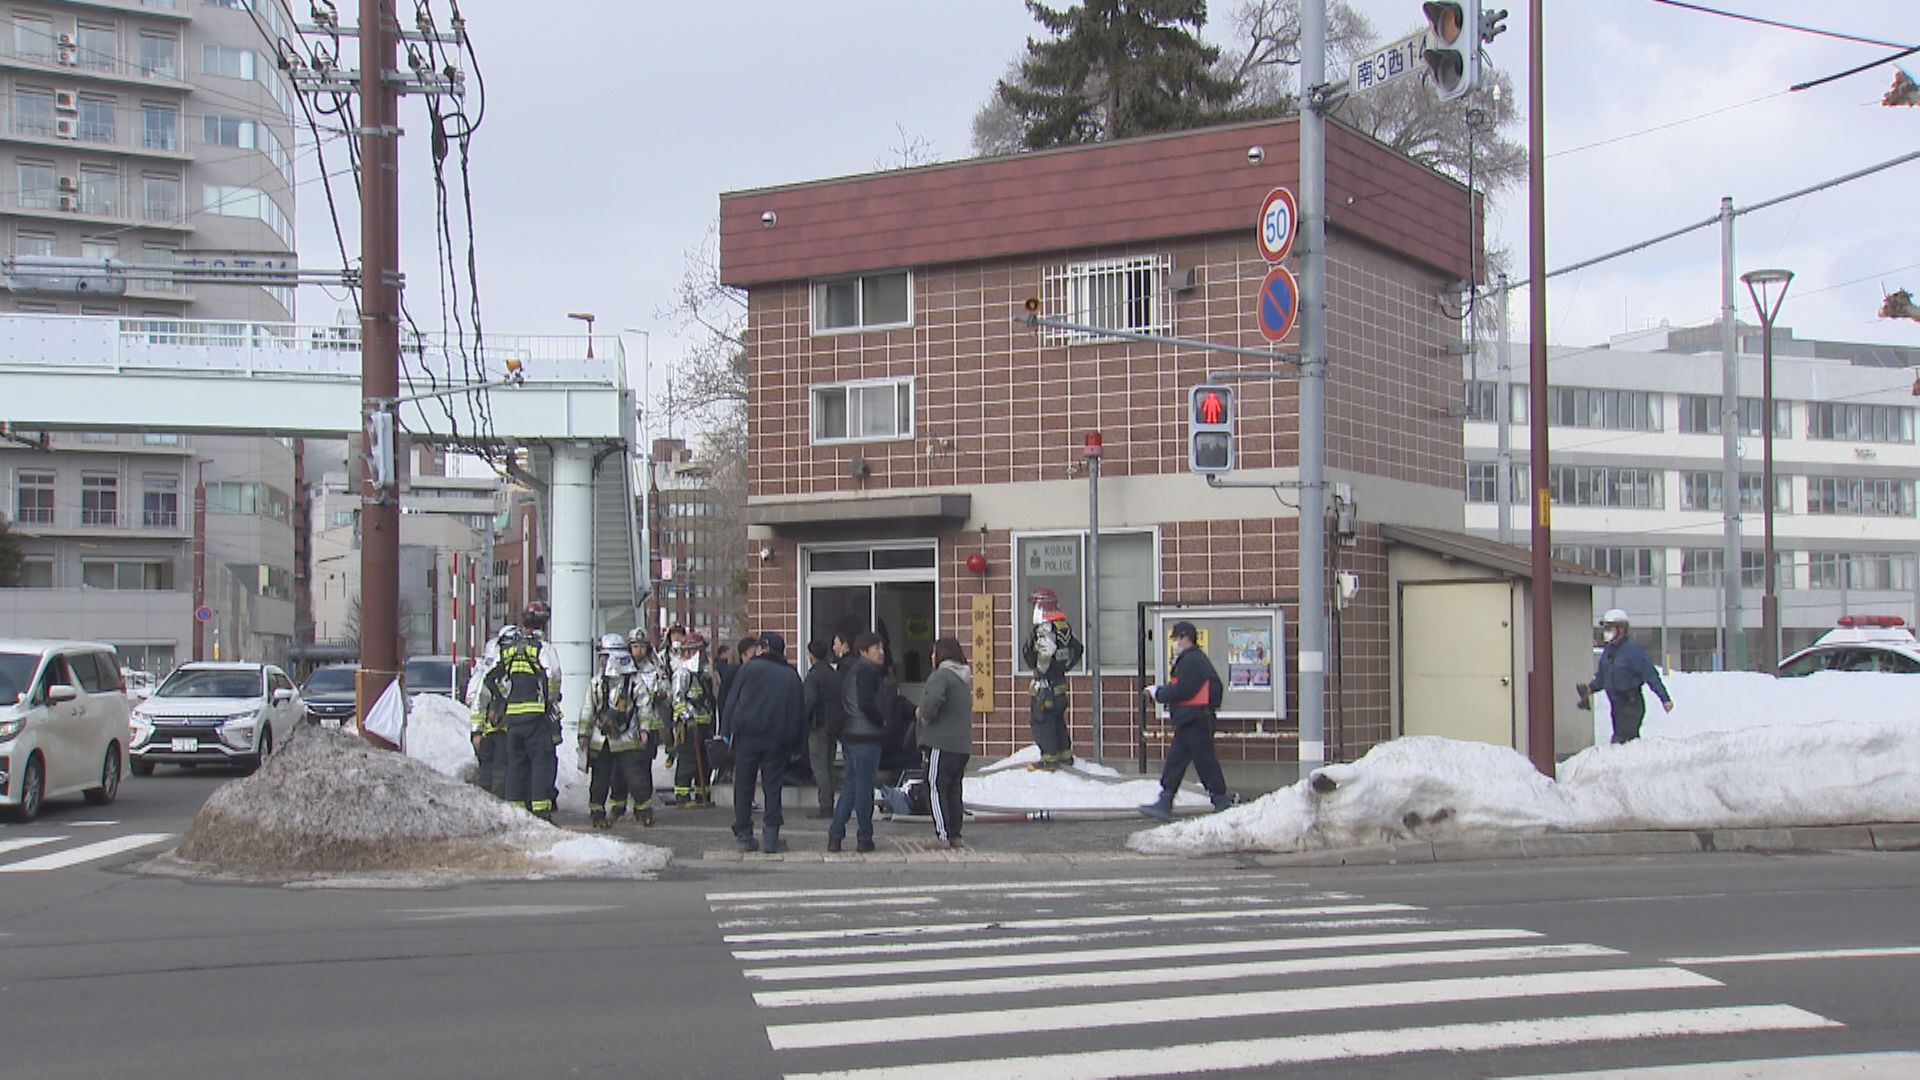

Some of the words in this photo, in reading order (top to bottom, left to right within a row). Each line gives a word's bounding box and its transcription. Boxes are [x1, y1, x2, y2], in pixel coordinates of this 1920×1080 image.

[1266, 208, 1287, 244] 50
[1044, 544, 1073, 557] KOBAN
[1044, 560, 1073, 572] POLICE
